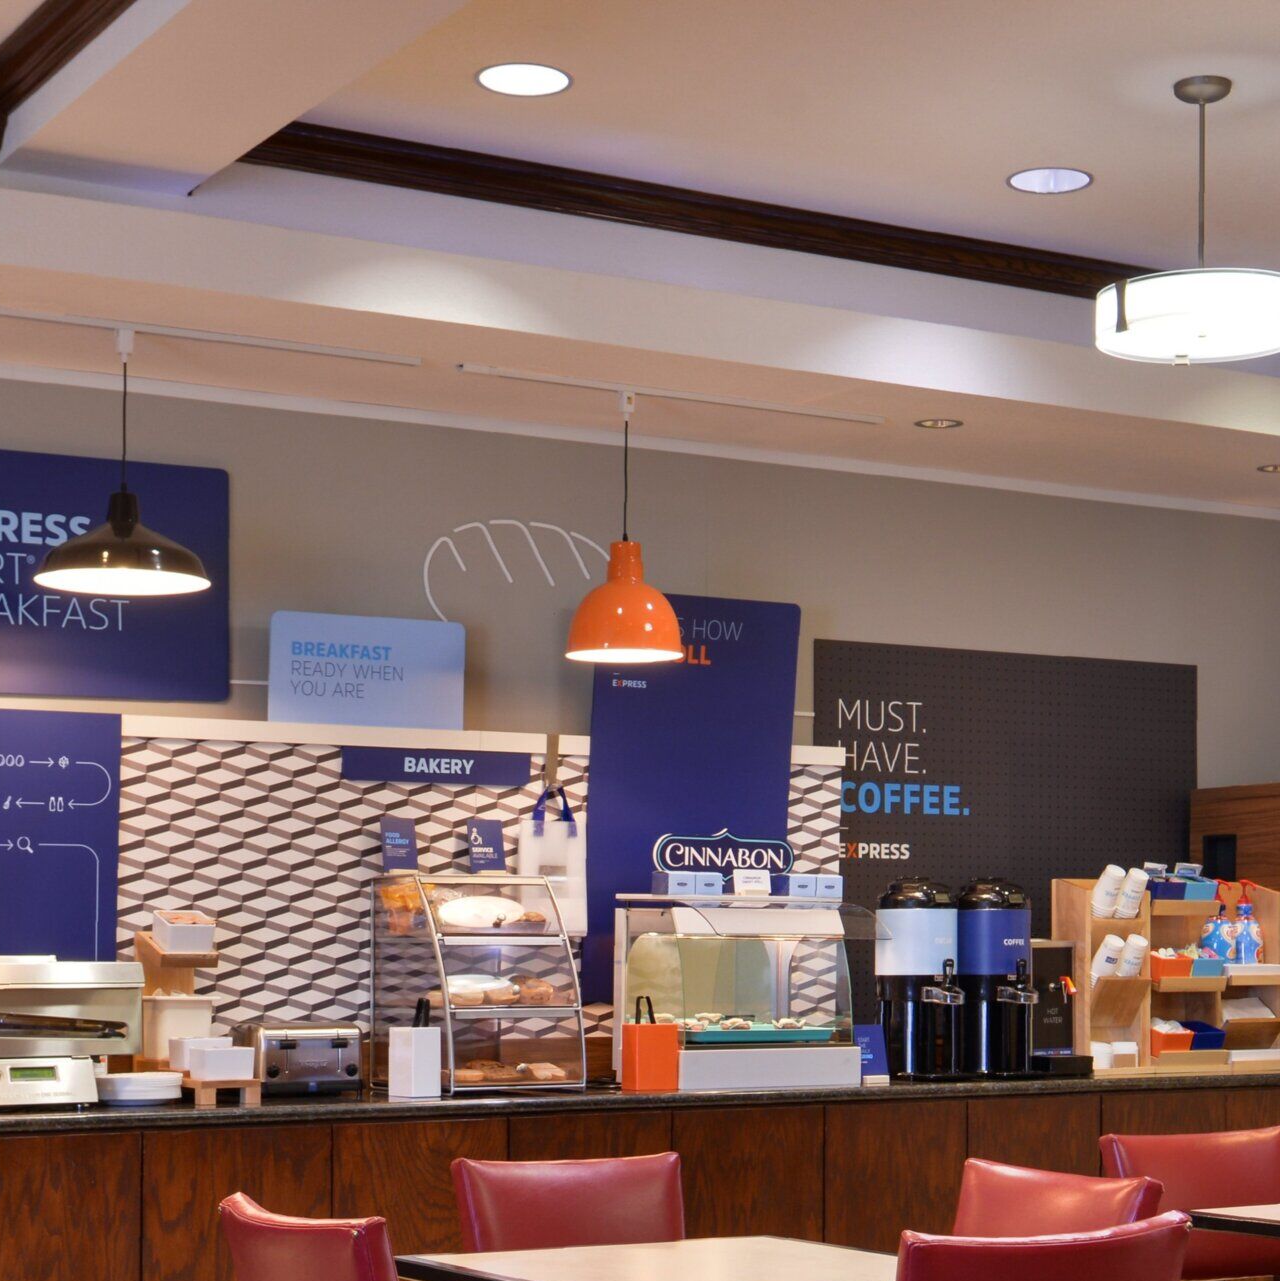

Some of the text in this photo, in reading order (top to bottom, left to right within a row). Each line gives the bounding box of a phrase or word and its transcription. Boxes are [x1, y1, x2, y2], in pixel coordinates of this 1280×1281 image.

[692, 617, 743, 640] HOW
[291, 641, 392, 661] BREAKFAST
[291, 660, 404, 682] READY WHEN
[290, 680, 365, 699] YOU ARE
[612, 679, 647, 688] EXPRESS
[839, 698, 926, 733] MUST.
[404, 757, 474, 774] BAKERY
[838, 740, 926, 774] HAVE.
[840, 781, 969, 816] COFFEE.
[666, 843, 784, 869] CINNABON
[839, 842, 910, 860] EXPRESS
[1042, 1016, 1063, 1024] WATER
